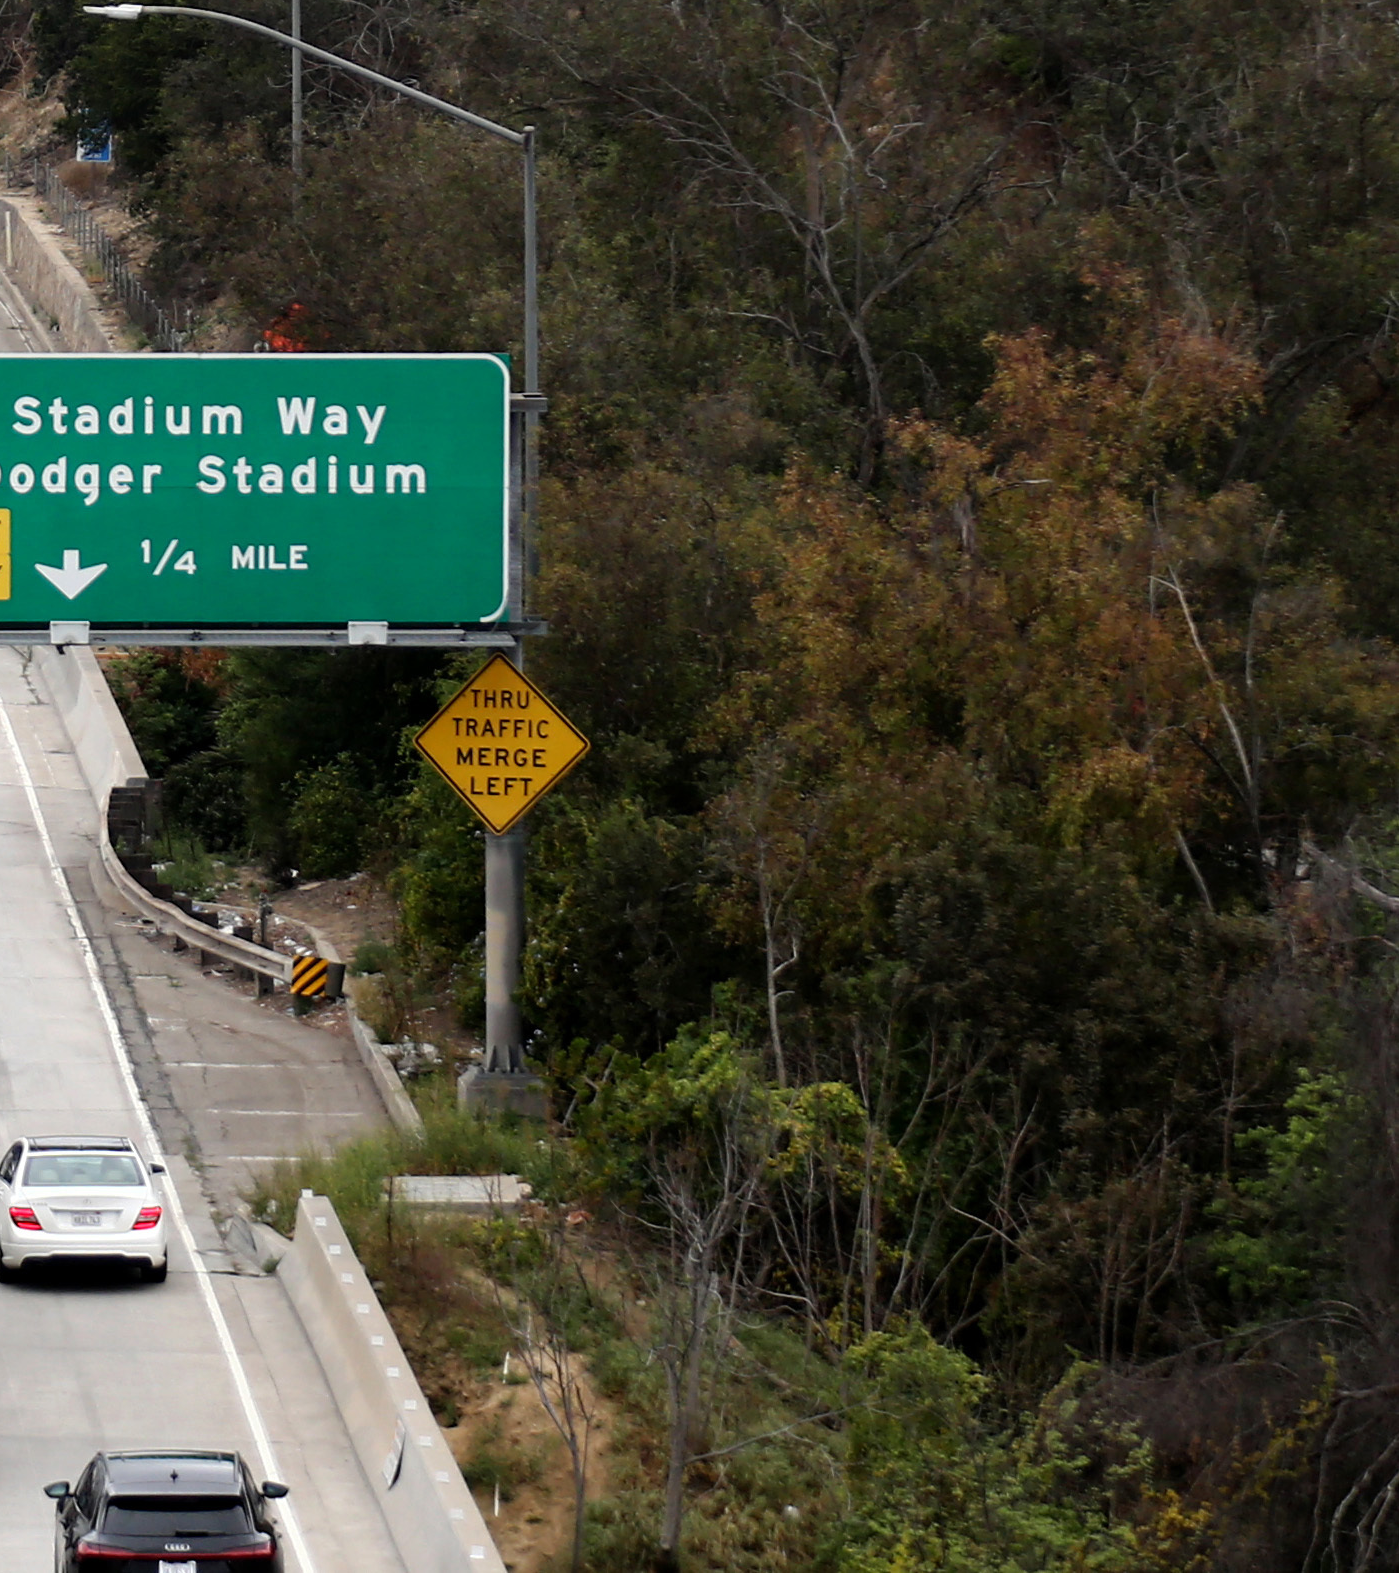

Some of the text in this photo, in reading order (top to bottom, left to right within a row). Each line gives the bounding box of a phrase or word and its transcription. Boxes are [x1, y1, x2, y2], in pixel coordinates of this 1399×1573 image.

[13, 397, 385, 444] Stadium Way
[197, 456, 425, 494] Stadium
[233, 546, 307, 569] MILE
[470, 689, 530, 709] THRU
[452, 717, 549, 739] TRAFFIC
[456, 747, 546, 768] MERGE
[470, 776, 533, 796] LEFT
